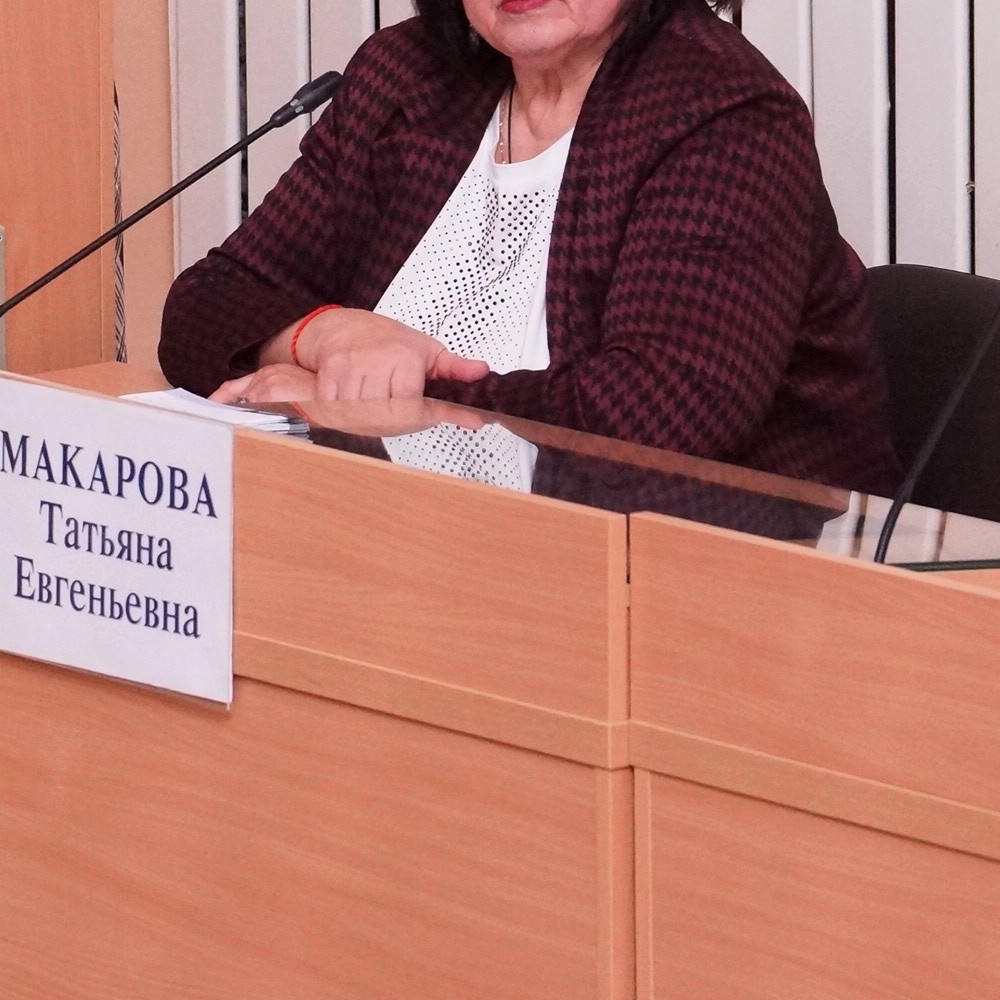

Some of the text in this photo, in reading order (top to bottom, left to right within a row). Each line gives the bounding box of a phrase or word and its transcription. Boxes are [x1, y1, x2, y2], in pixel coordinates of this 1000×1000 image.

[0, 429, 218, 519] МАКАРОВА
[39, 499, 174, 571] Татьяна
[14, 554, 201, 639] Евгеньевна
